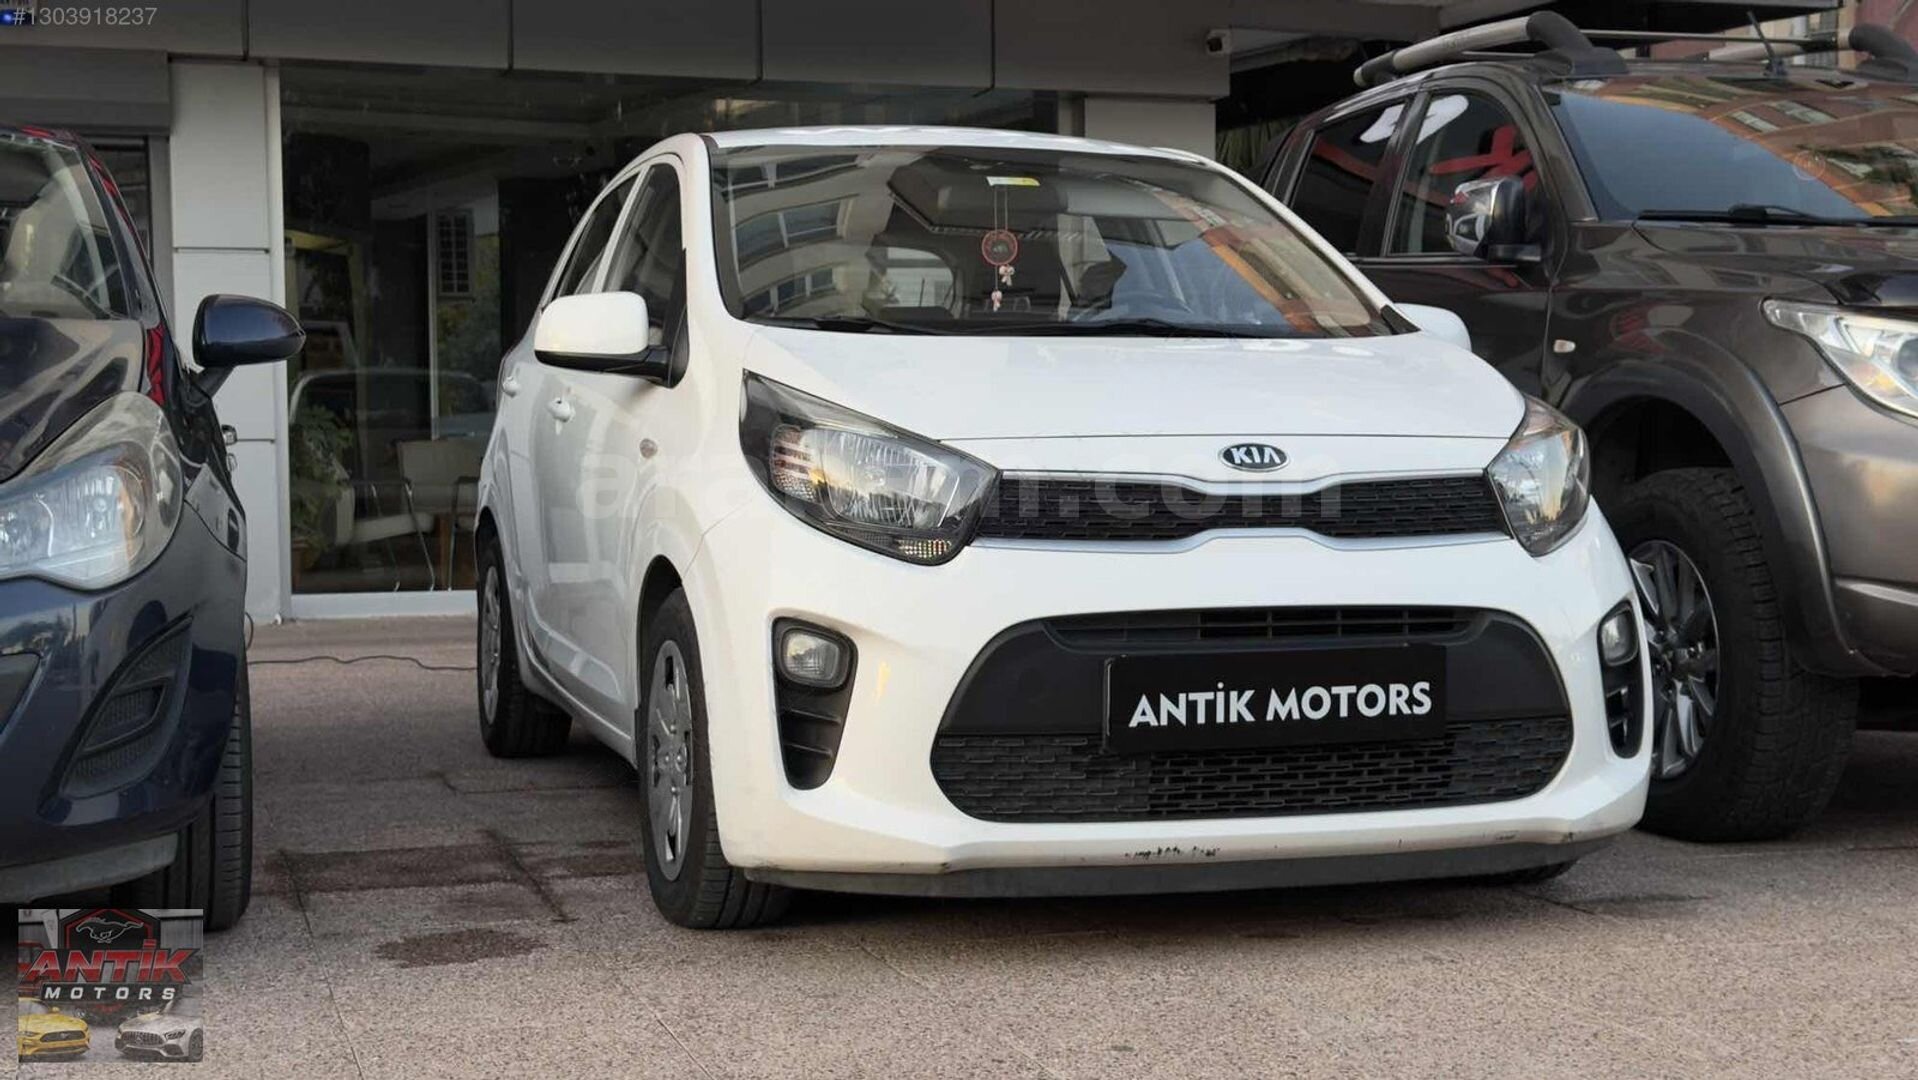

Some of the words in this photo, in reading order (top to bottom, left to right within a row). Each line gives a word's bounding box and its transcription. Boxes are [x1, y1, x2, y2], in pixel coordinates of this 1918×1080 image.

[1230, 446, 1281, 464] KIA
[1128, 682, 1255, 728] ANTİK
[1266, 681, 1432, 722] MOTORS
